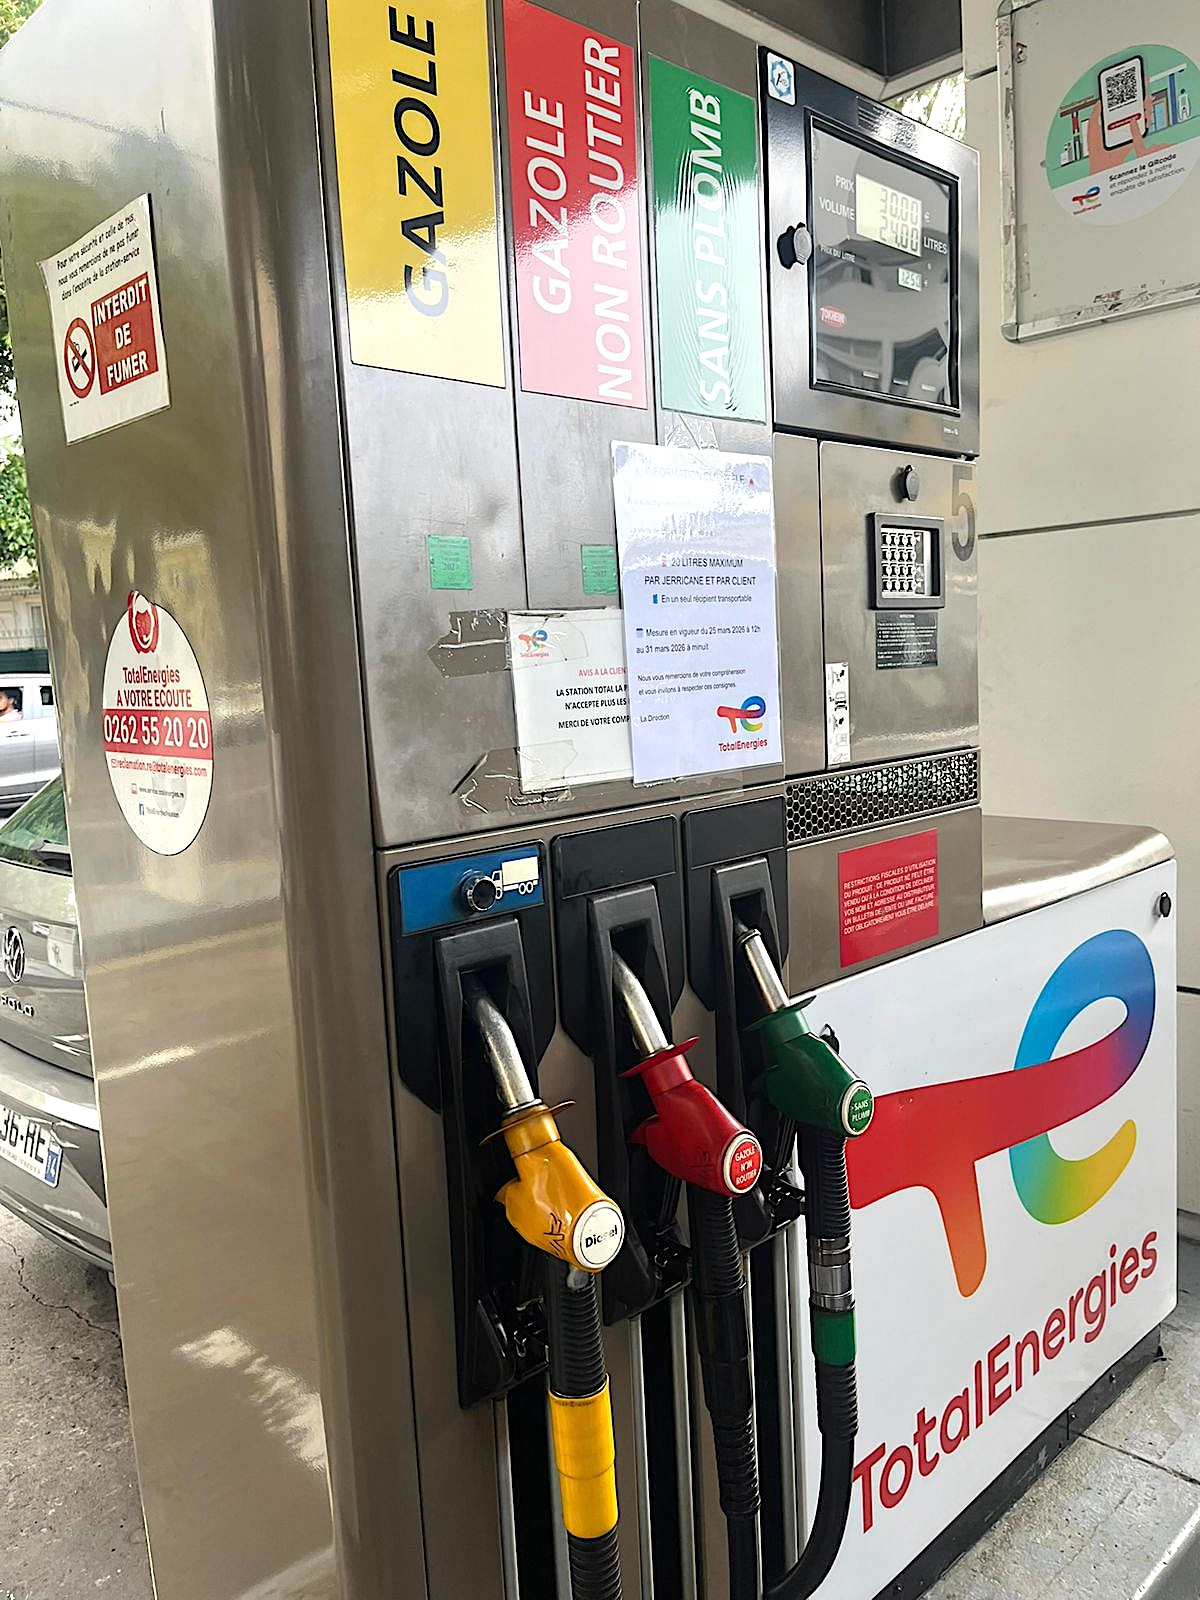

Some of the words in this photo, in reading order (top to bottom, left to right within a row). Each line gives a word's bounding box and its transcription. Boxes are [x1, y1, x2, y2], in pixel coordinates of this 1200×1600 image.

[389, 5, 449, 317] GAZOLE
[583, 36, 627, 272] ROUTIER
[689, 89, 728, 267] PLOMB
[835, 175, 855, 193] PRIX
[1109, 168, 1138, 182] Scannez
[523, 90, 572, 314] GAZOLE
[819, 196, 856, 221] VOLUME
[57, 259, 68, 270] Pour
[69, 250, 80, 262] votre
[80, 236, 98, 256] sécurité
[105, 225, 116, 239] celle
[117, 220, 124, 231] de
[69, 268, 78, 279] vous
[78, 253, 102, 274] remercions
[102, 248, 108, 258] de
[110, 244, 116, 254] ne
[116, 238, 125, 252] pas
[126, 228, 139, 244] fumer
[923, 236, 949, 256] LITRES
[62, 290, 72, 301] dans
[92, 270, 98, 282] de
[105, 247, 140, 275] station-service
[92, 277, 148, 328] INTERDIT
[114, 322, 132, 350] DE
[594, 284, 634, 402] NON
[696, 280, 731, 404] SANS
[106, 350, 149, 387] FUMER
[951, 463, 975, 561] 5
[682, 558, 708, 568] LITRES
[708, 558, 744, 568] MAXIMUM
[644, 576, 660, 585] PAR
[662, 576, 704, 586] JERRICANE
[705, 576, 716, 586] ET
[716, 576, 731, 586] PAR
[732, 576, 756, 586] CLIENT
[661, 594, 670, 604] En
[680, 594, 692, 603] seul
[692, 594, 717, 604] récipient
[718, 594, 752, 604] transportable
[646, 628, 669, 637] Mesure
[678, 628, 700, 638] vigueur
[708, 626, 716, 634] 25
[732, 626, 745, 634] 2026
[751, 624, 761, 633] 12h
[645, 646, 653, 654] 31
[670, 644, 686, 652] 2026
[687, 644, 691, 652] à
[692, 643, 709, 651] minuit
[122, 664, 180, 688] TotalEnergies
[578, 668, 593, 677] AVIS
[600, 668, 608, 676] LA
[665, 672, 692, 681] remercions
[712, 668, 746, 678] compréhension
[556, 688, 565, 696] LA
[566, 687, 593, 696] STATION
[594, 686, 614, 694] TOTAL
[658, 686, 676, 694] invitons
[682, 684, 703, 694] respecter
[116, 690, 123, 706] A
[124, 690, 154, 707] VOTRE
[154, 690, 192, 708] ECOUTE
[565, 700, 600, 710] N'ACCEPTE
[600, 699, 616, 707] PLUS
[616, 698, 627, 706] LES
[558, 720, 580, 729] MERCI
[580, 719, 589, 727] DE
[590, 717, 610, 726] VOTRE
[612, 715, 630, 724] COMP
[648, 713, 670, 722] Direction
[104, 714, 139, 744] 0262
[140, 715, 160, 746] 55
[162, 716, 184, 748] 20
[187, 716, 209, 749] 20
[718, 738, 768, 752] TotalEnergies
[880, 867, 904, 879] FISCALES
[853, 1100, 868, 1111] SANS
[734, 1146, 756, 1162] GAZOLE
[740, 1158, 753, 1172] NON
[736, 1168, 757, 1186] ROUTIER
[851, 1230, 1158, 1535] TotalEnergies
